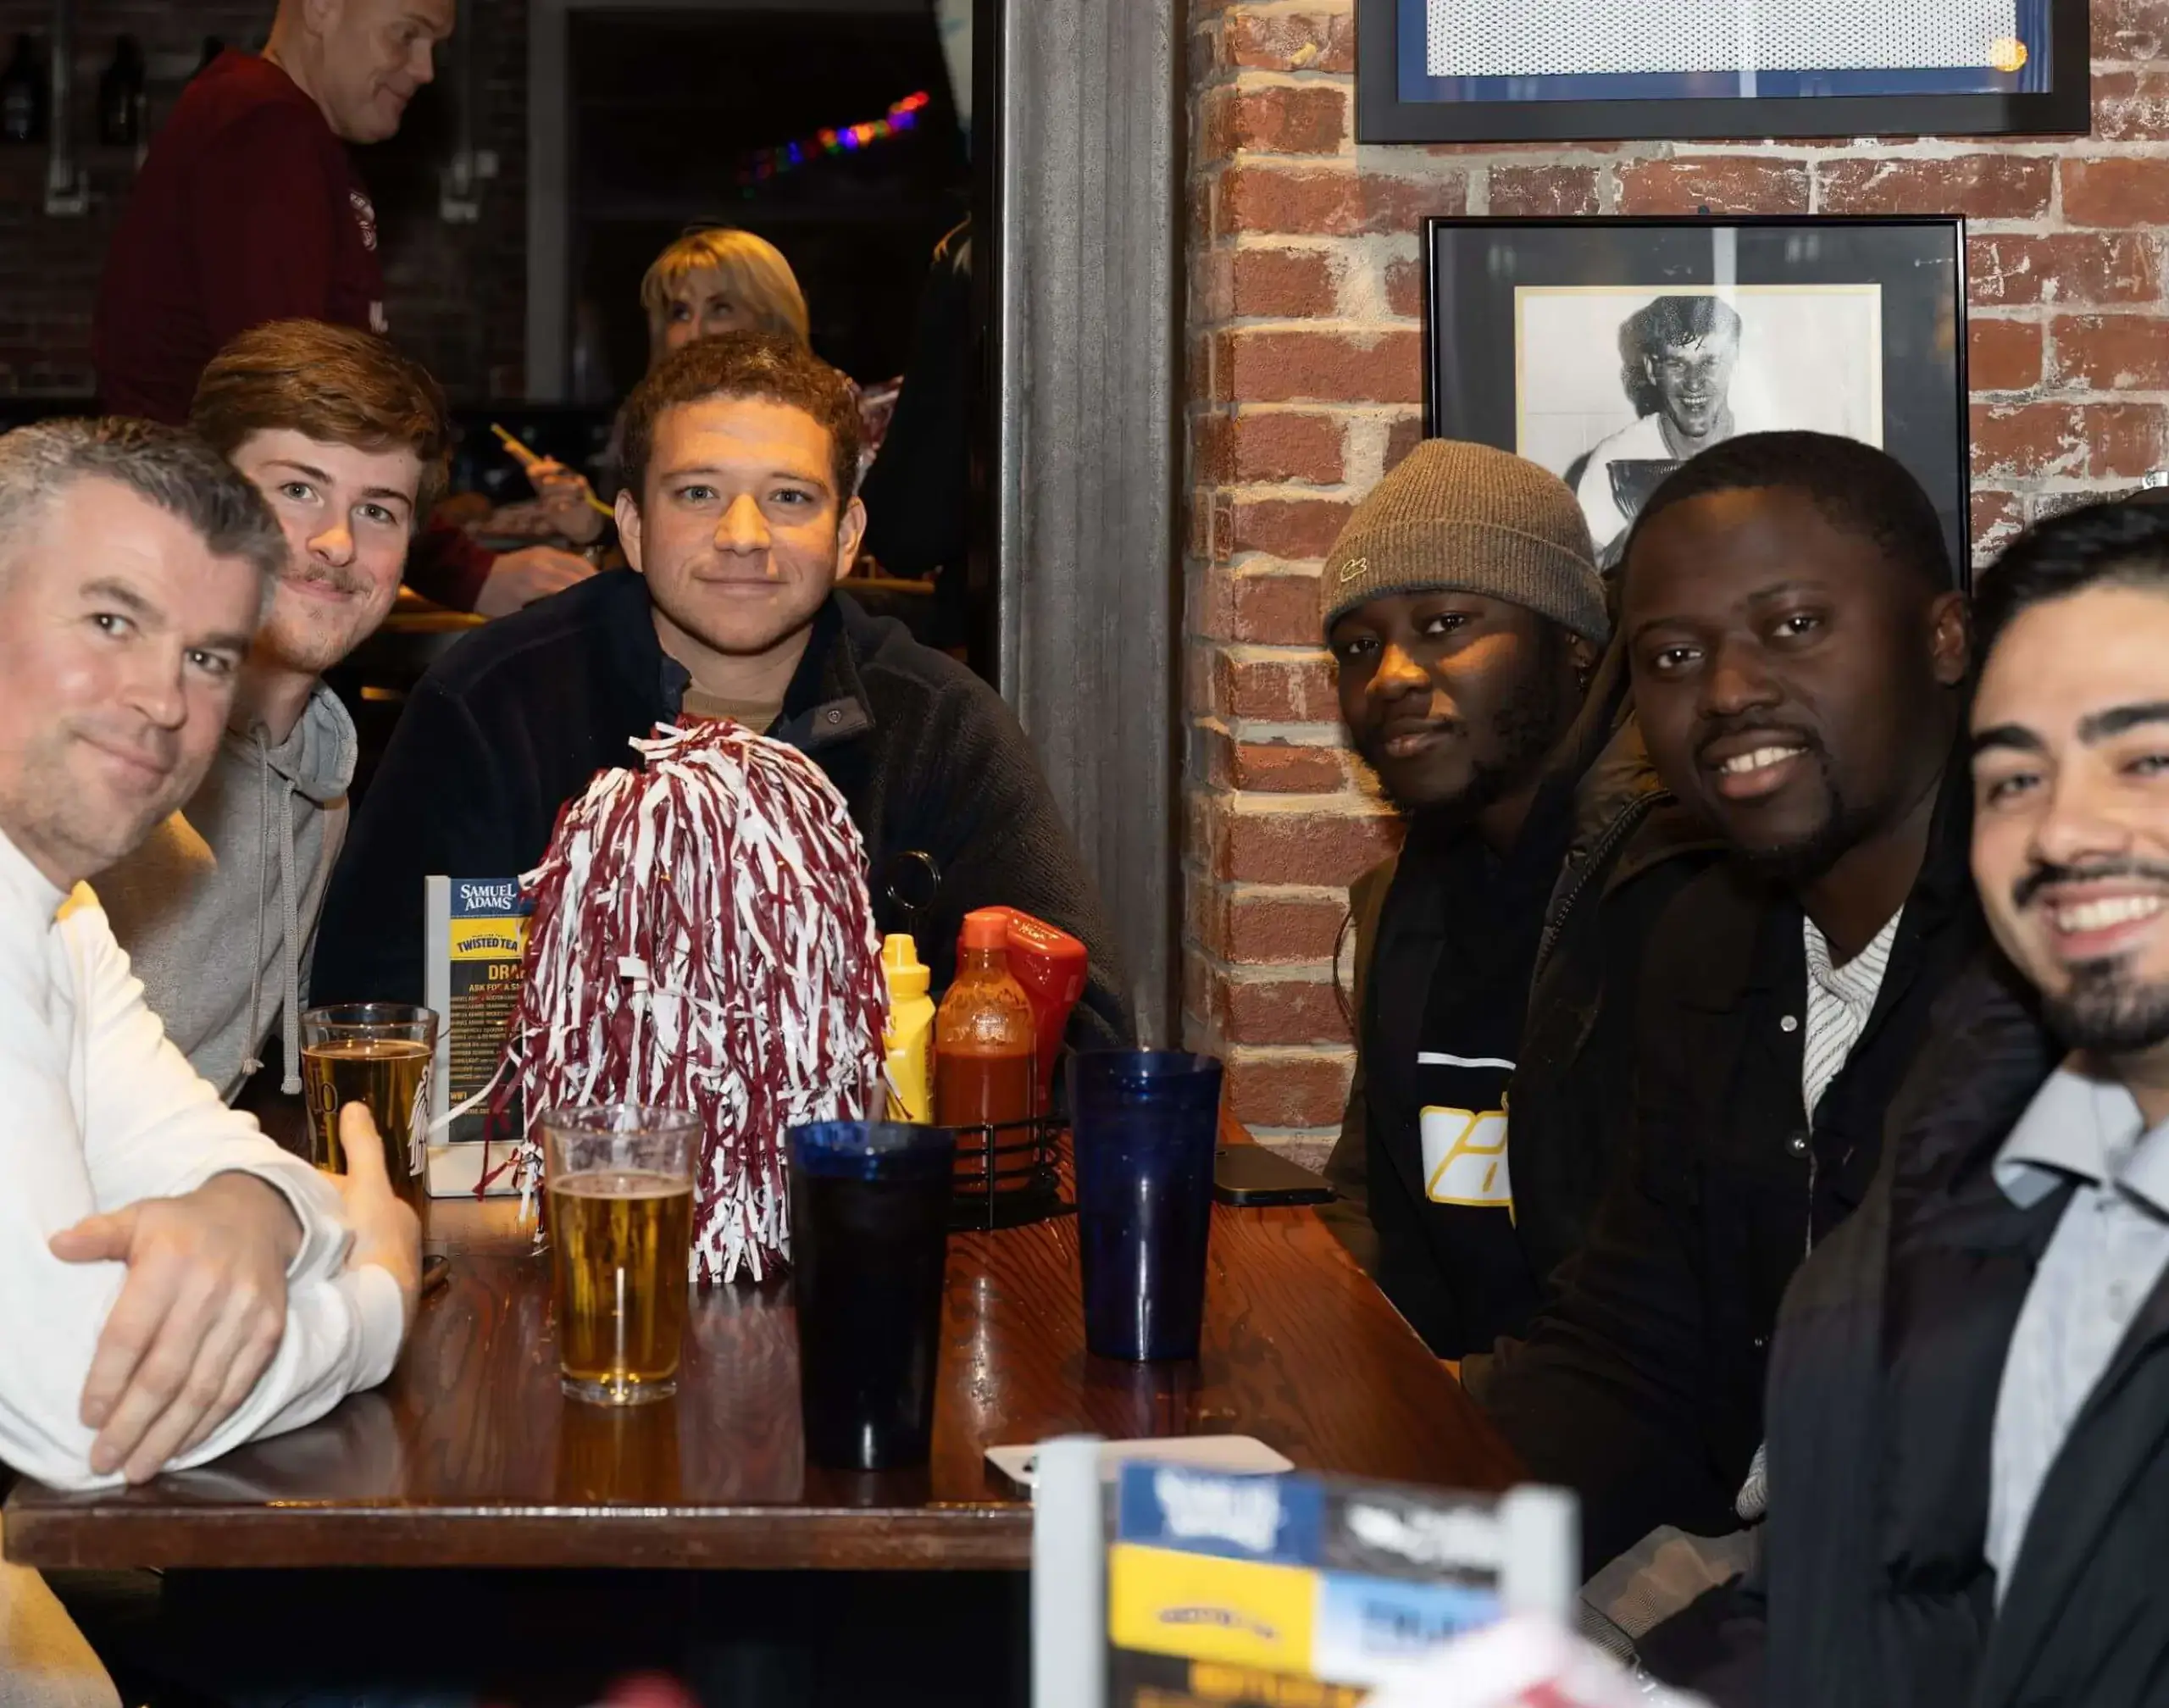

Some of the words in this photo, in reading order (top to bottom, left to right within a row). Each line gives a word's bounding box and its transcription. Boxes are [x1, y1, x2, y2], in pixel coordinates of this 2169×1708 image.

[460, 884, 516, 899] SAMUEL
[465, 897, 512, 912] ADAMS
[457, 938, 499, 953] TWISTED
[500, 938, 518, 952] TEA
[469, 984, 485, 993] ASK
